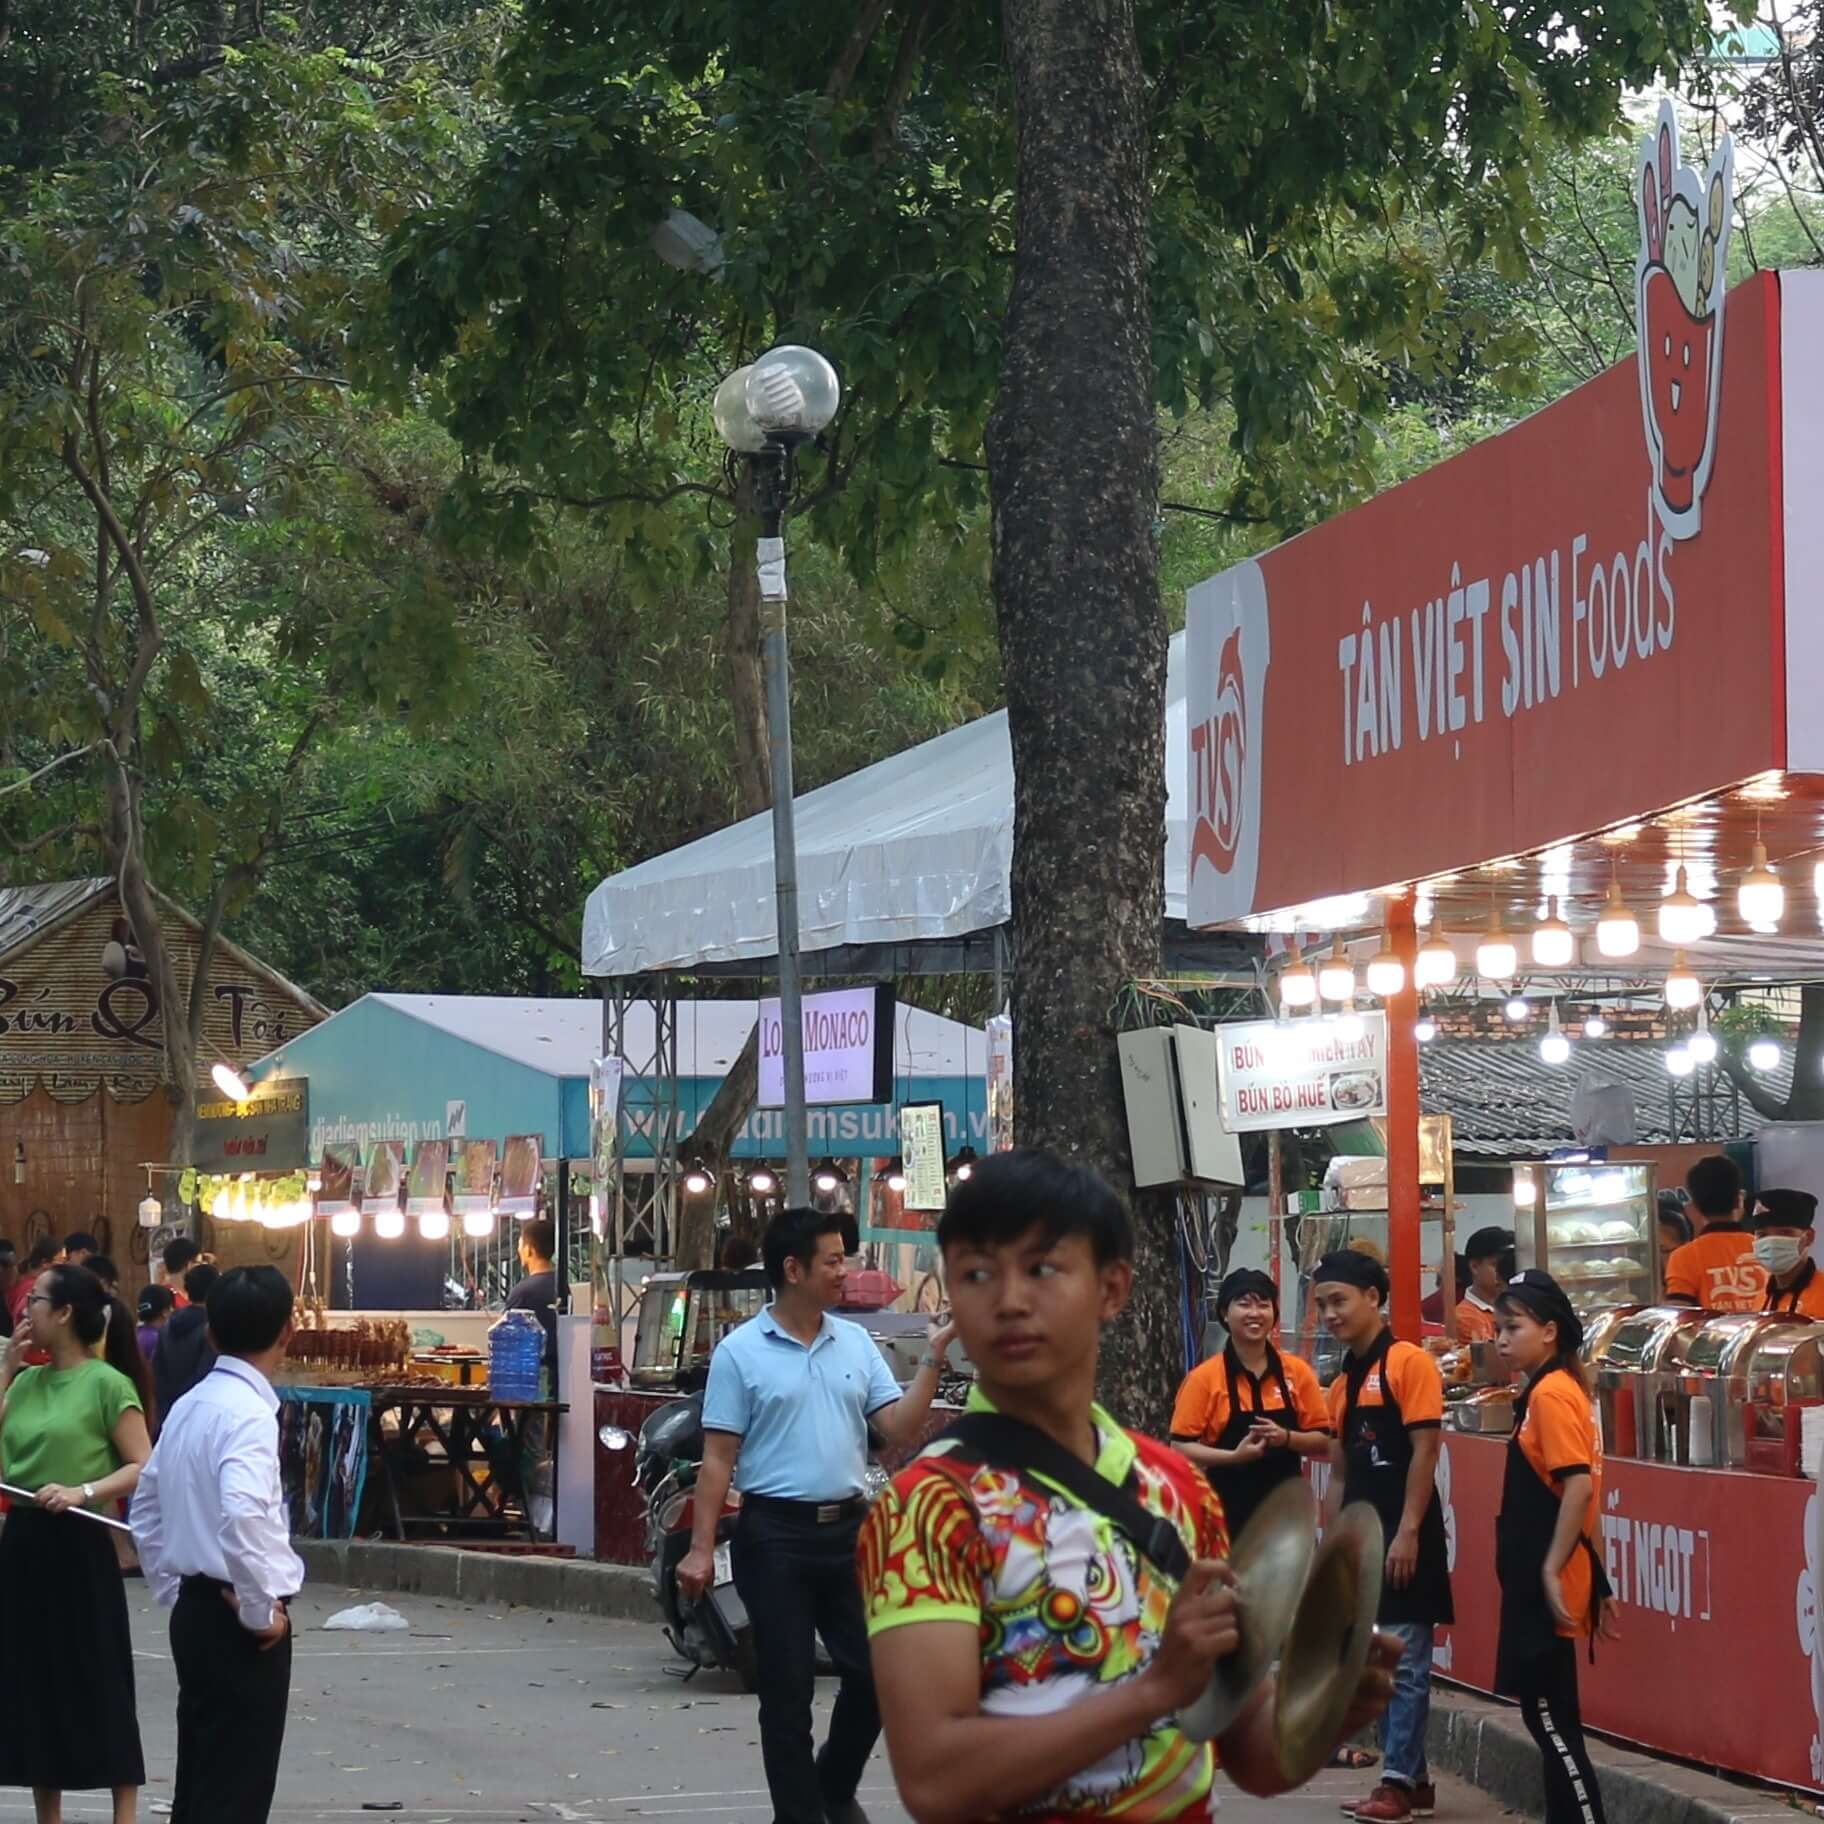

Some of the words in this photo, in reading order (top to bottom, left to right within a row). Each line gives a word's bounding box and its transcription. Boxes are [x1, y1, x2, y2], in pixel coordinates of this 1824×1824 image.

[1339, 600, 1401, 765] TÂN
[1411, 561, 1490, 760] VIỆT
[1501, 549, 1559, 717] SIN
[1572, 492, 1675, 688] Foods
[804, 1010, 869, 1053] MONACO
[1238, 1082, 1268, 1113] BÚN
[1272, 1079, 1292, 1110] BÒ
[1297, 1072, 1326, 1108] HUẾ
[1634, 1521, 1695, 1633] NGỌT
